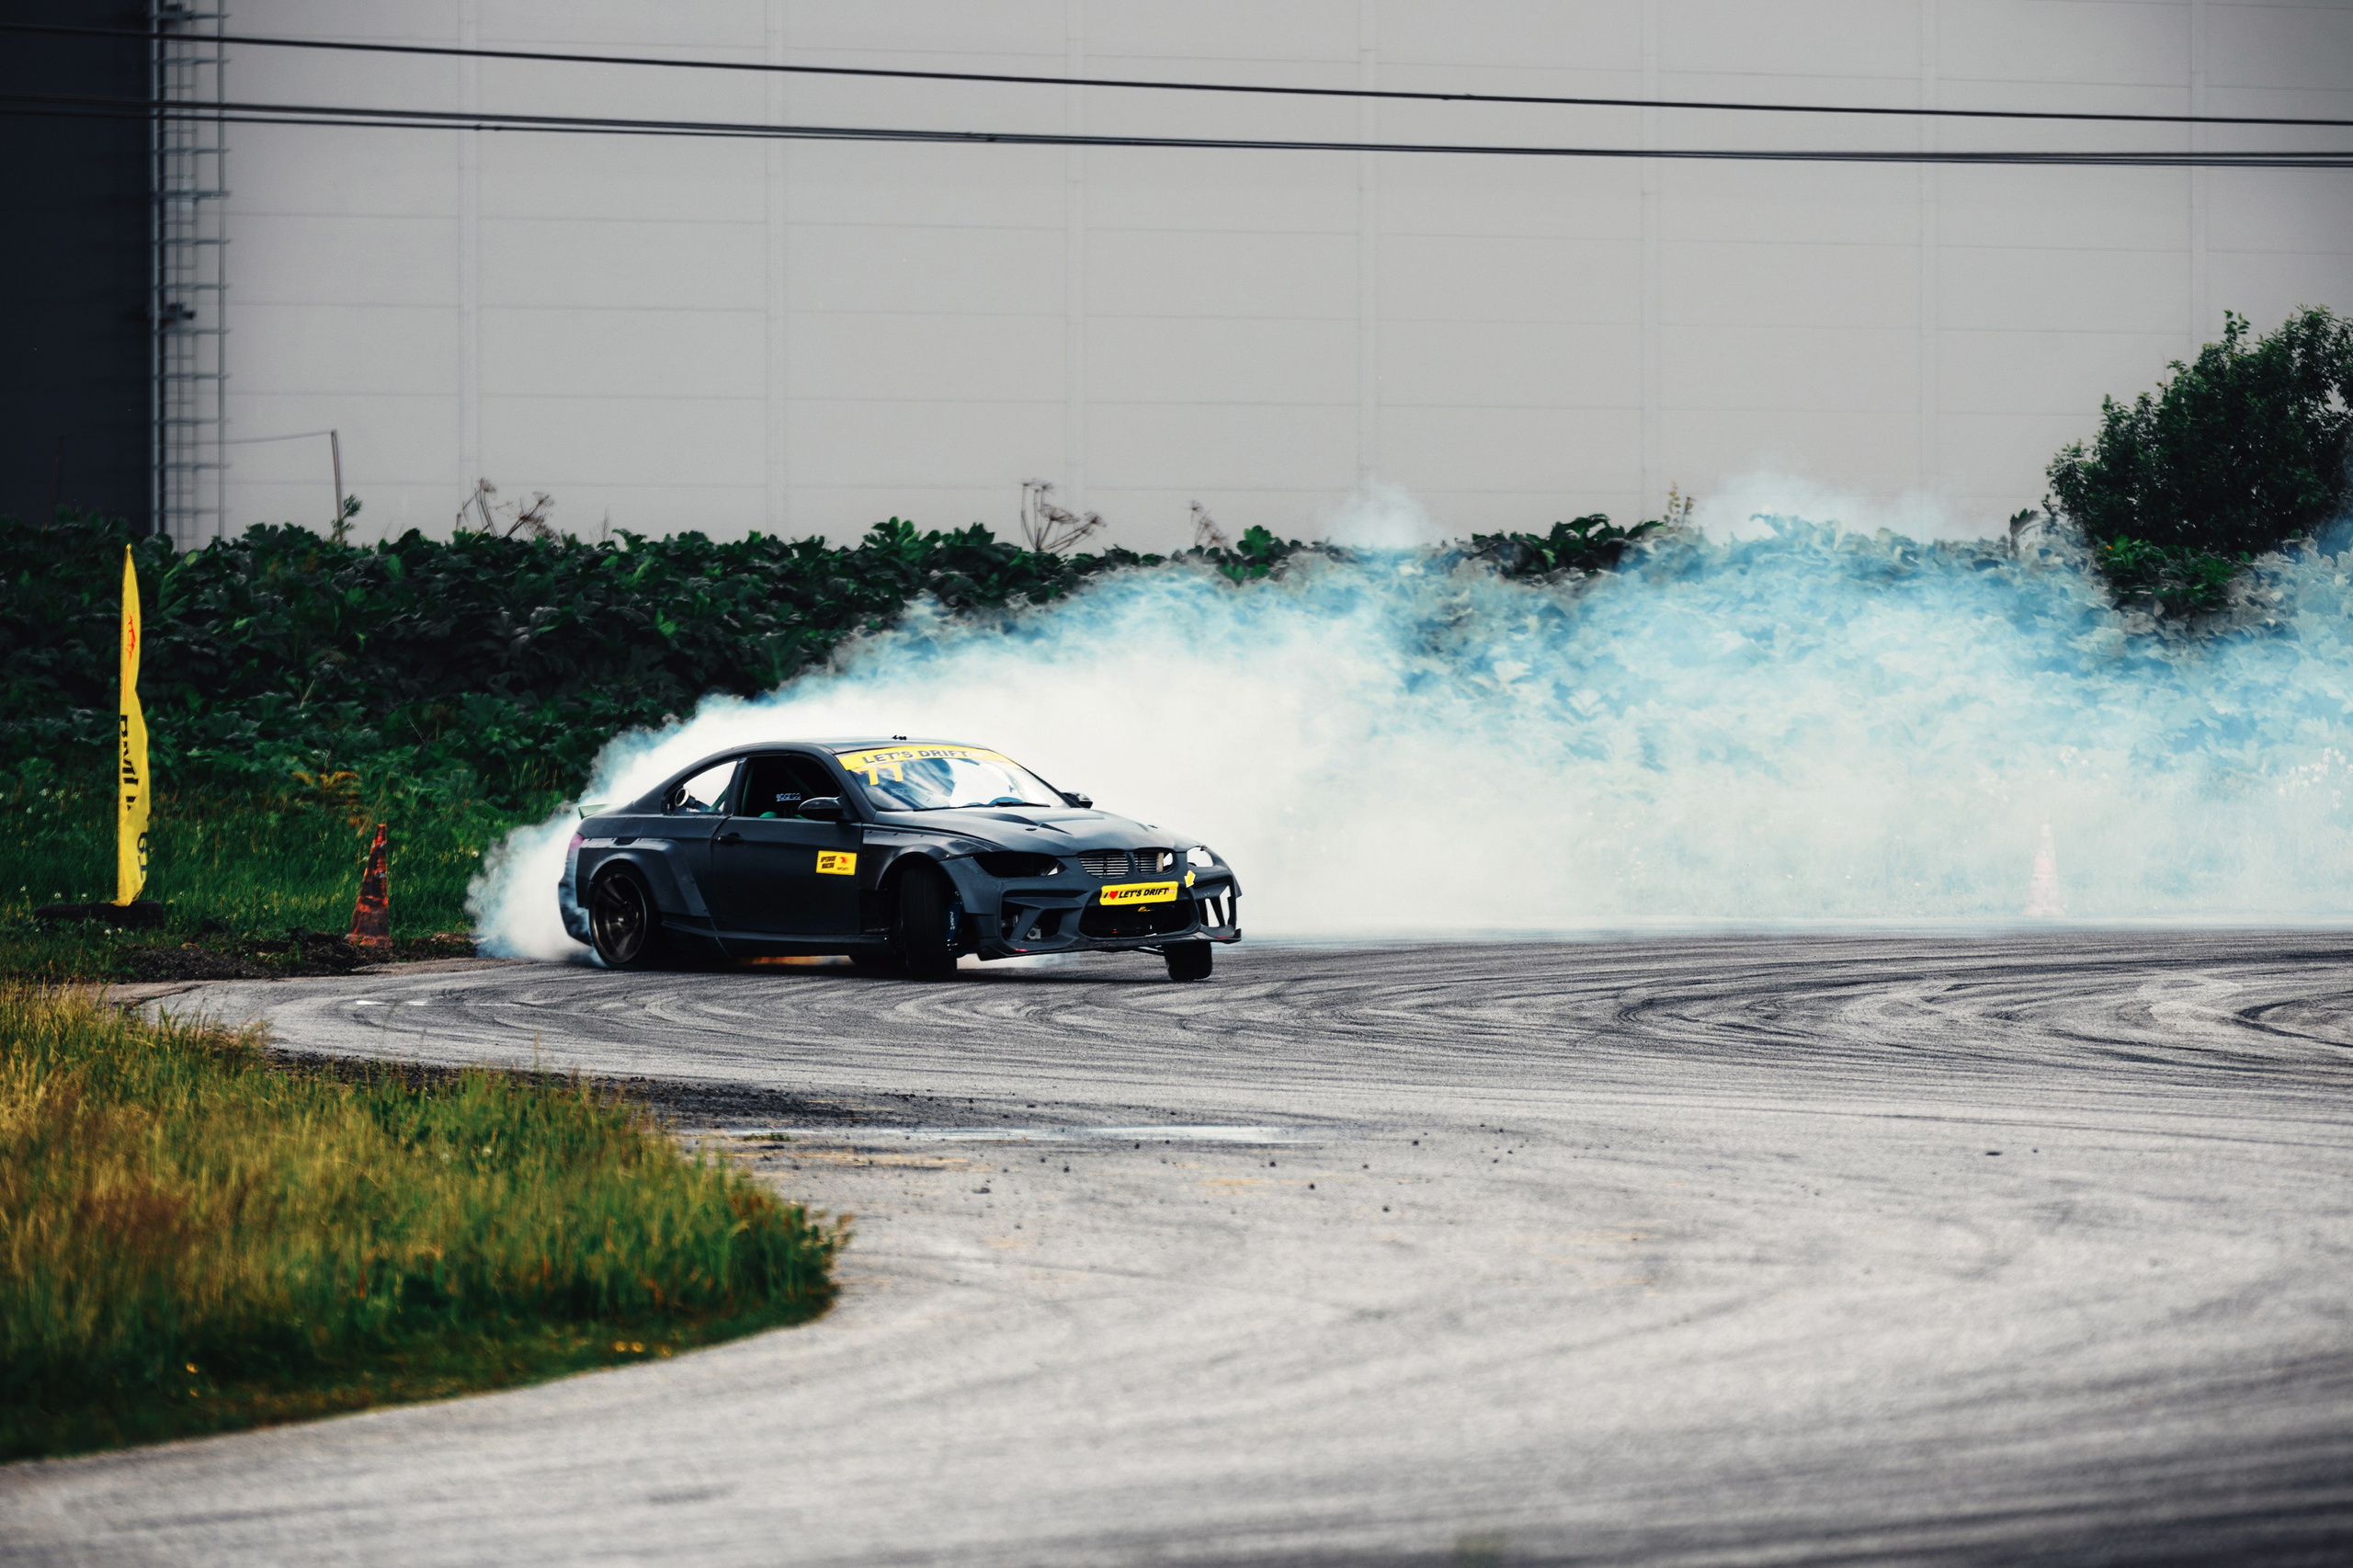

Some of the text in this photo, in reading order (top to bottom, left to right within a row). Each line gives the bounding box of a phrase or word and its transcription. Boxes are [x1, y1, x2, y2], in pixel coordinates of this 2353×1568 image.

[862, 751, 915, 764] LET'S
[918, 749, 968, 758] DRIFT
[853, 763, 904, 786] 77
[1118, 889, 1142, 899] LET'S
[1143, 888, 1169, 896] DRIFT
